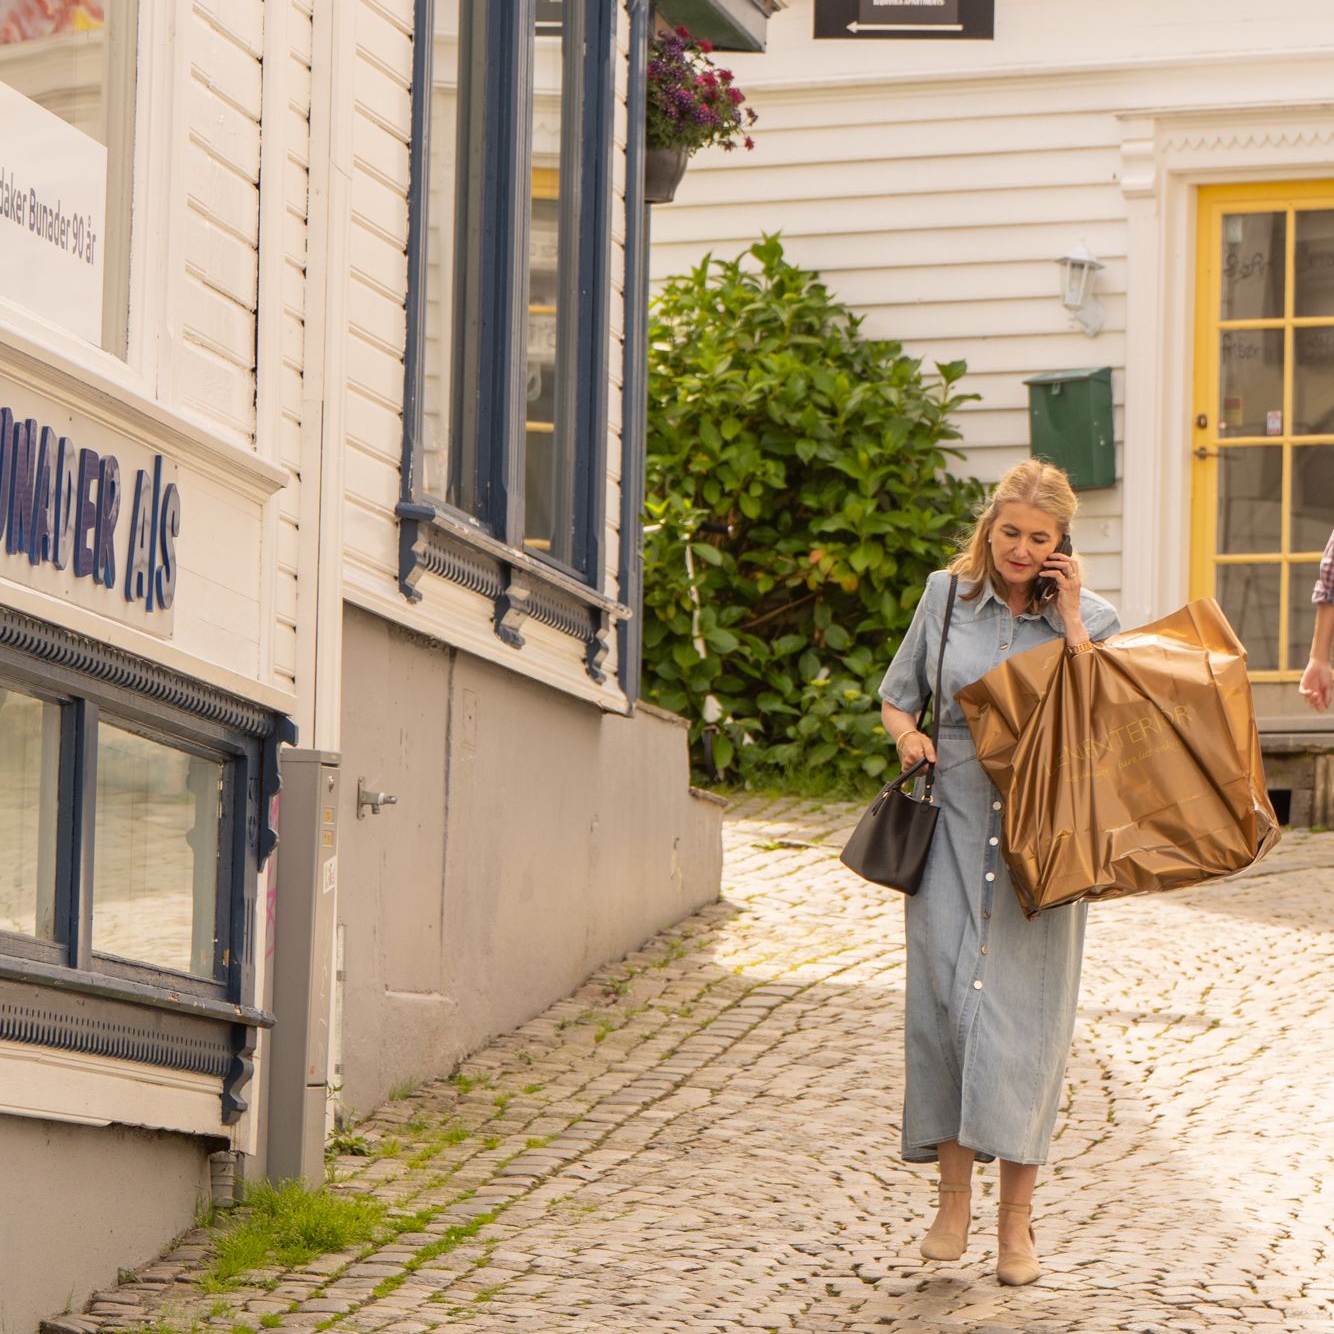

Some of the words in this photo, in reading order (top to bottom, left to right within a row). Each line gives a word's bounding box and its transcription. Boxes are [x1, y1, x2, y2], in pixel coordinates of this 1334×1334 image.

[29, 187, 71, 251] Bunader
[72, 212, 84, 260] 90
[85, 214, 97, 265] år
